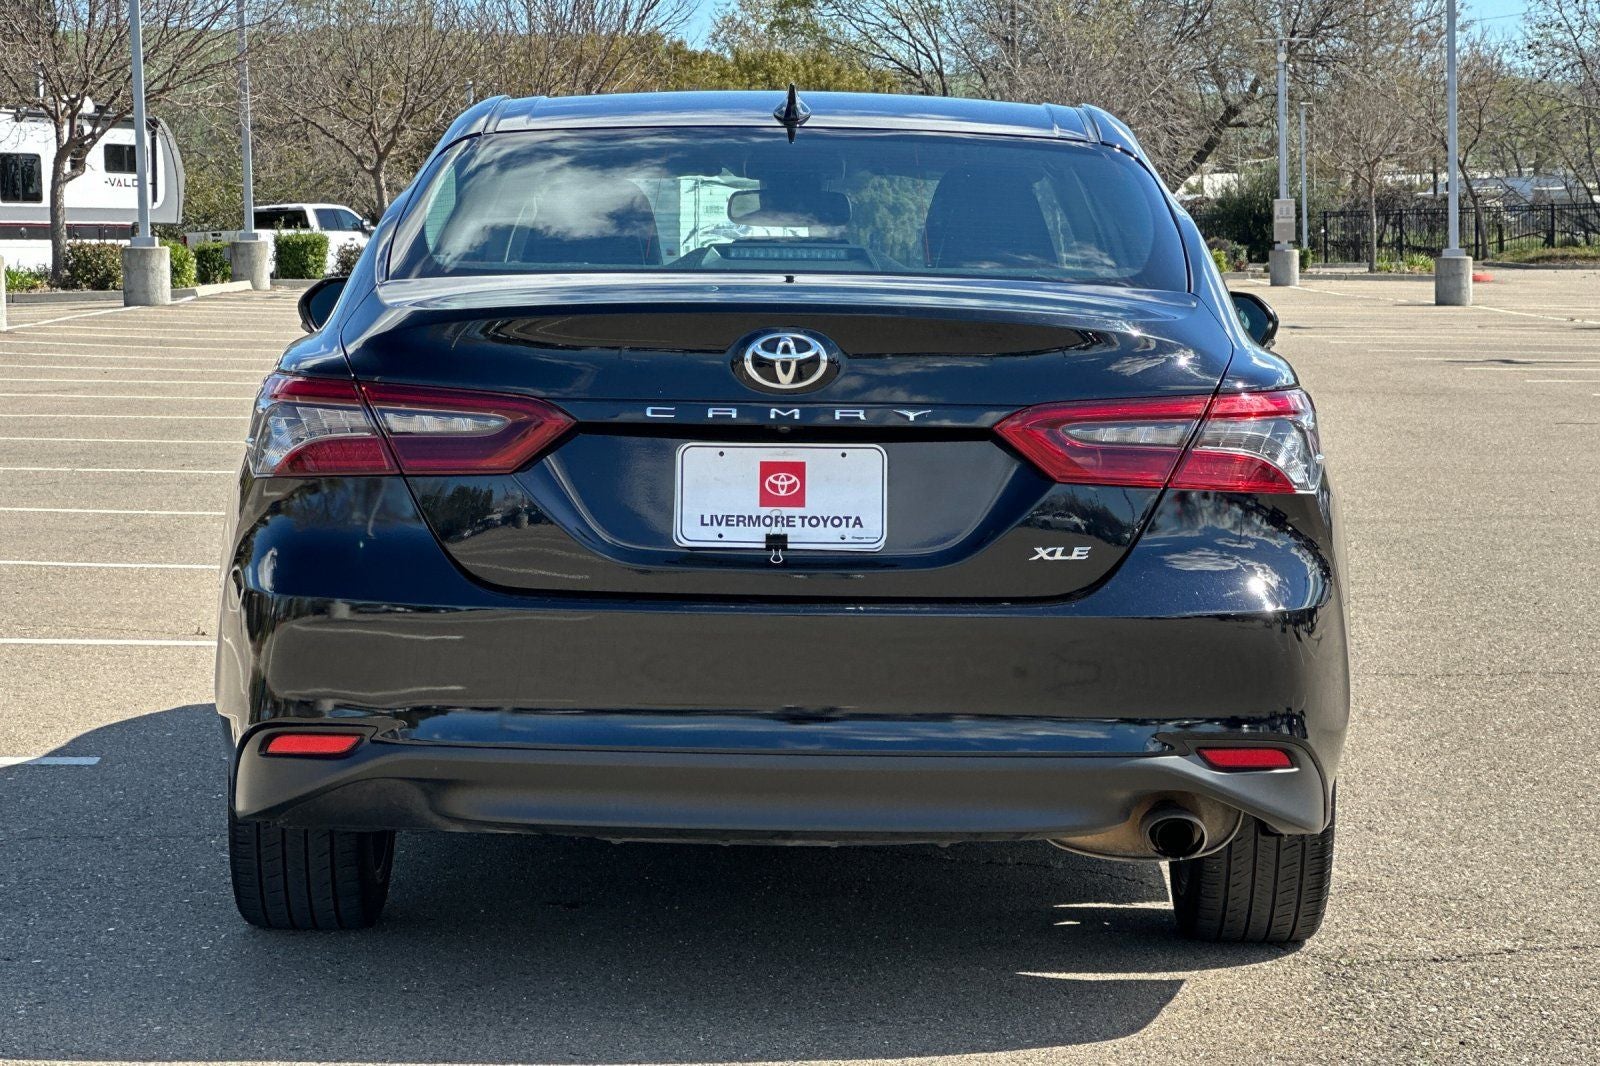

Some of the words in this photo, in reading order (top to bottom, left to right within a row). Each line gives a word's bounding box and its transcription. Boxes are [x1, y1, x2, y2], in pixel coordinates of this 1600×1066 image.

[646, 406, 932, 421] CAMRY
[700, 514, 796, 528] LIVERMORE
[799, 515, 864, 529] TOYOTA
[1029, 546, 1092, 561] XLE
